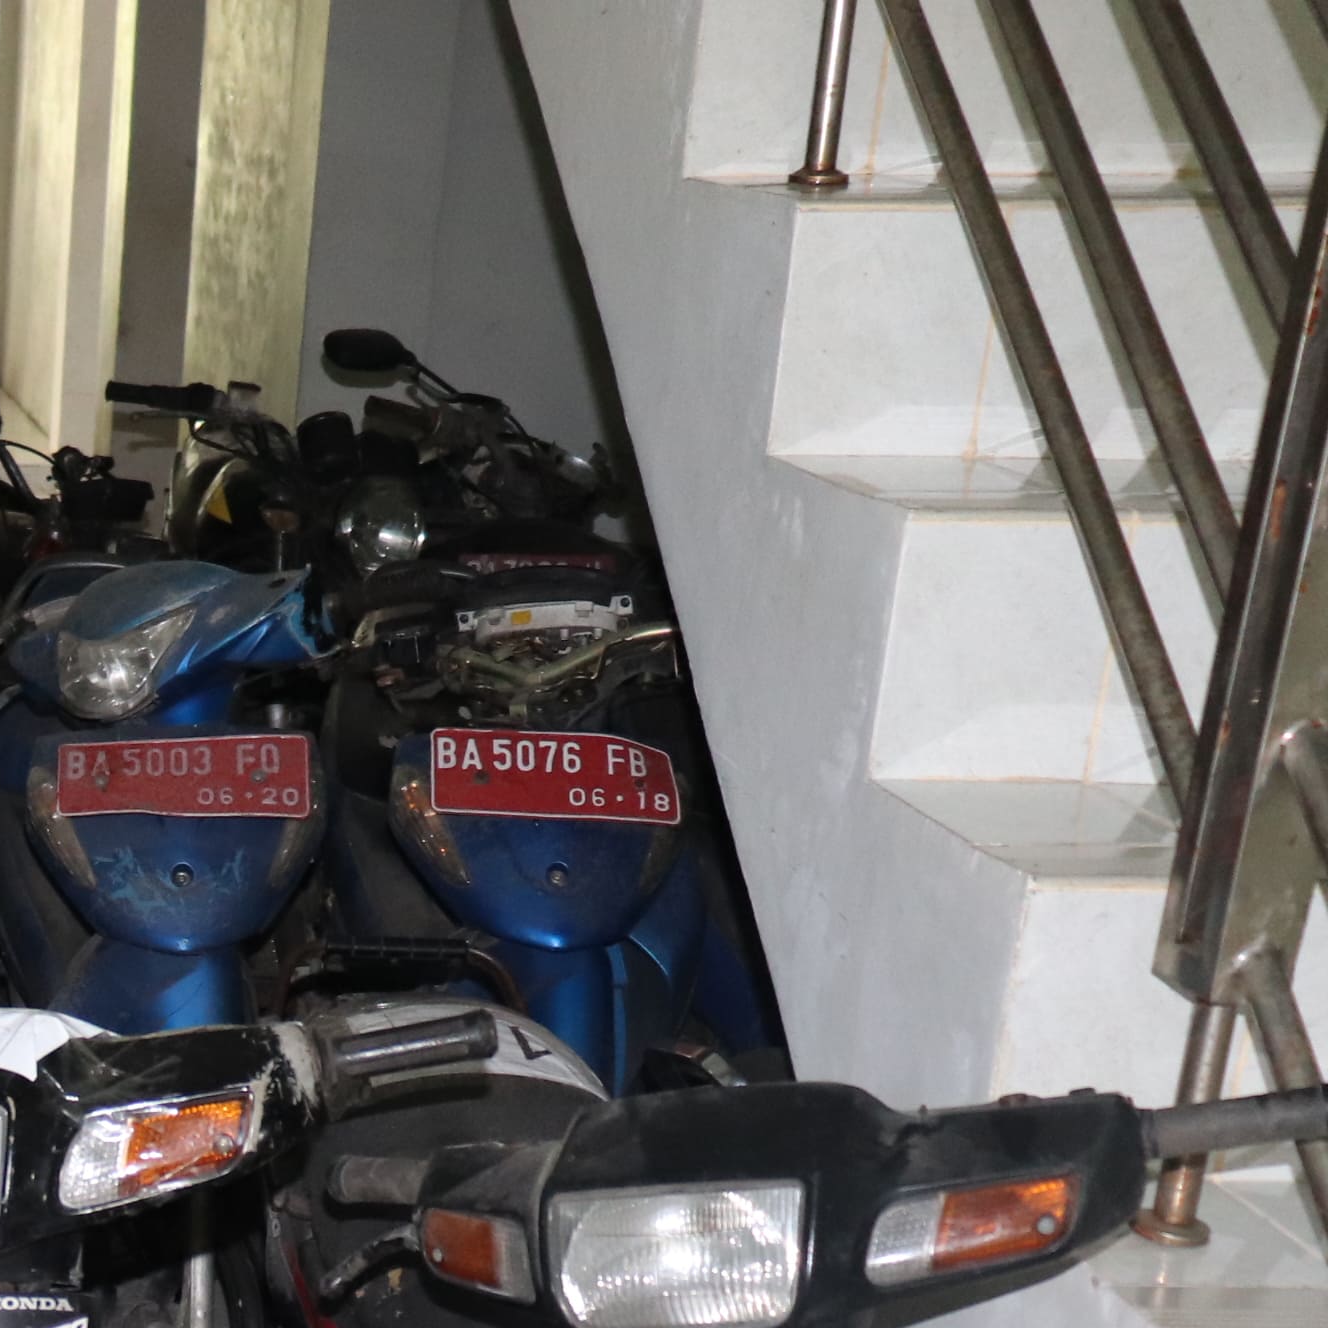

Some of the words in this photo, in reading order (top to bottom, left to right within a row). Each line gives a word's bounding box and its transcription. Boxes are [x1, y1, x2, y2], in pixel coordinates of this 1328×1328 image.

[66, 751, 111, 781] BA
[122, 746, 212, 777] 5003
[437, 737, 483, 770] BA
[493, 739, 582, 774] 5076
[606, 743, 647, 778] FB
